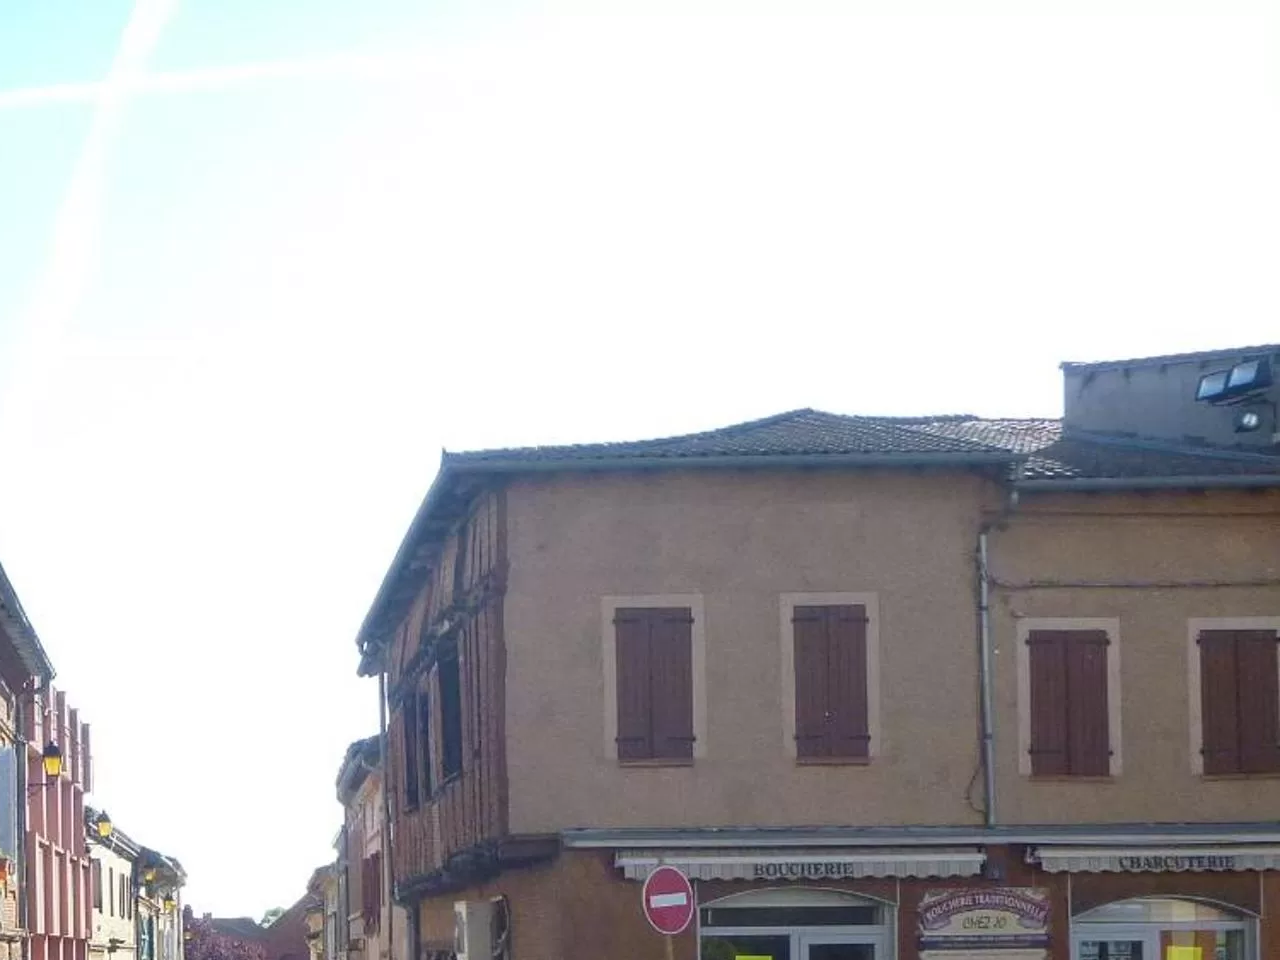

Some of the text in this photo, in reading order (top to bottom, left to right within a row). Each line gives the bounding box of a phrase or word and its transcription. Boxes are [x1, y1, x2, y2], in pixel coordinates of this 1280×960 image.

[753, 862, 854, 877] BOUCHERIE
[1119, 855, 1235, 870] CHARCUTERIE
[926, 893, 1047, 920] BOUCHERIE TRADITIONNELLE
